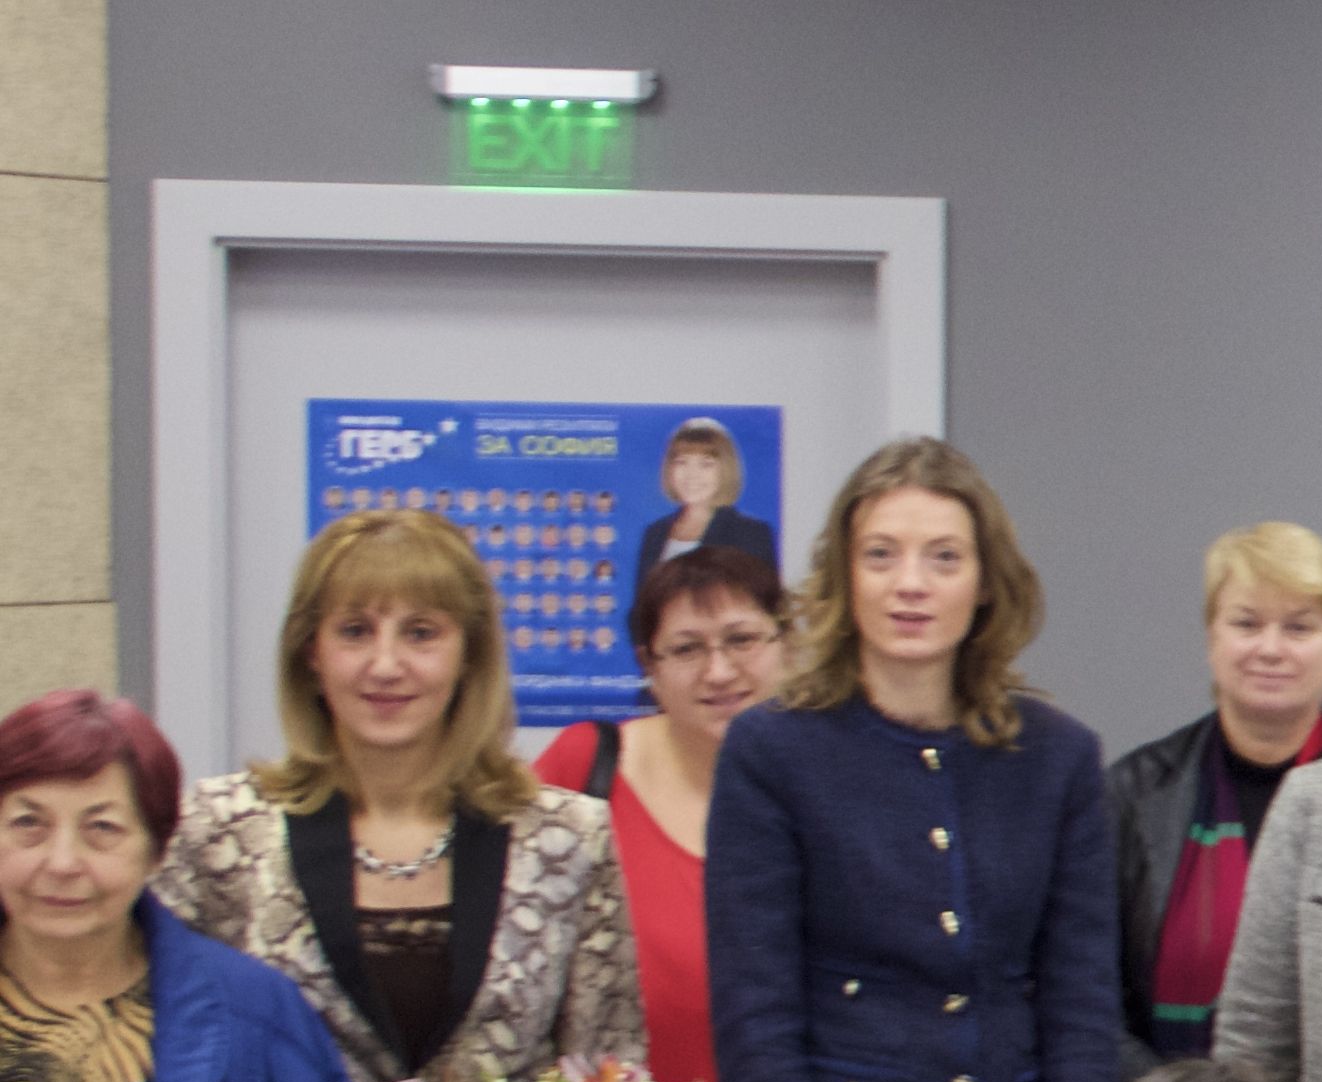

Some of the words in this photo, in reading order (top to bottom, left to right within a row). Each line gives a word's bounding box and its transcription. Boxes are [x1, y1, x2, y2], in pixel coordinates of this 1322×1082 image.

[468, 113, 620, 171] EXIT
[339, 429, 423, 459] ГЕРБ
[476, 434, 513, 455] ЗА
[518, 435, 619, 456] СОФИЯ
